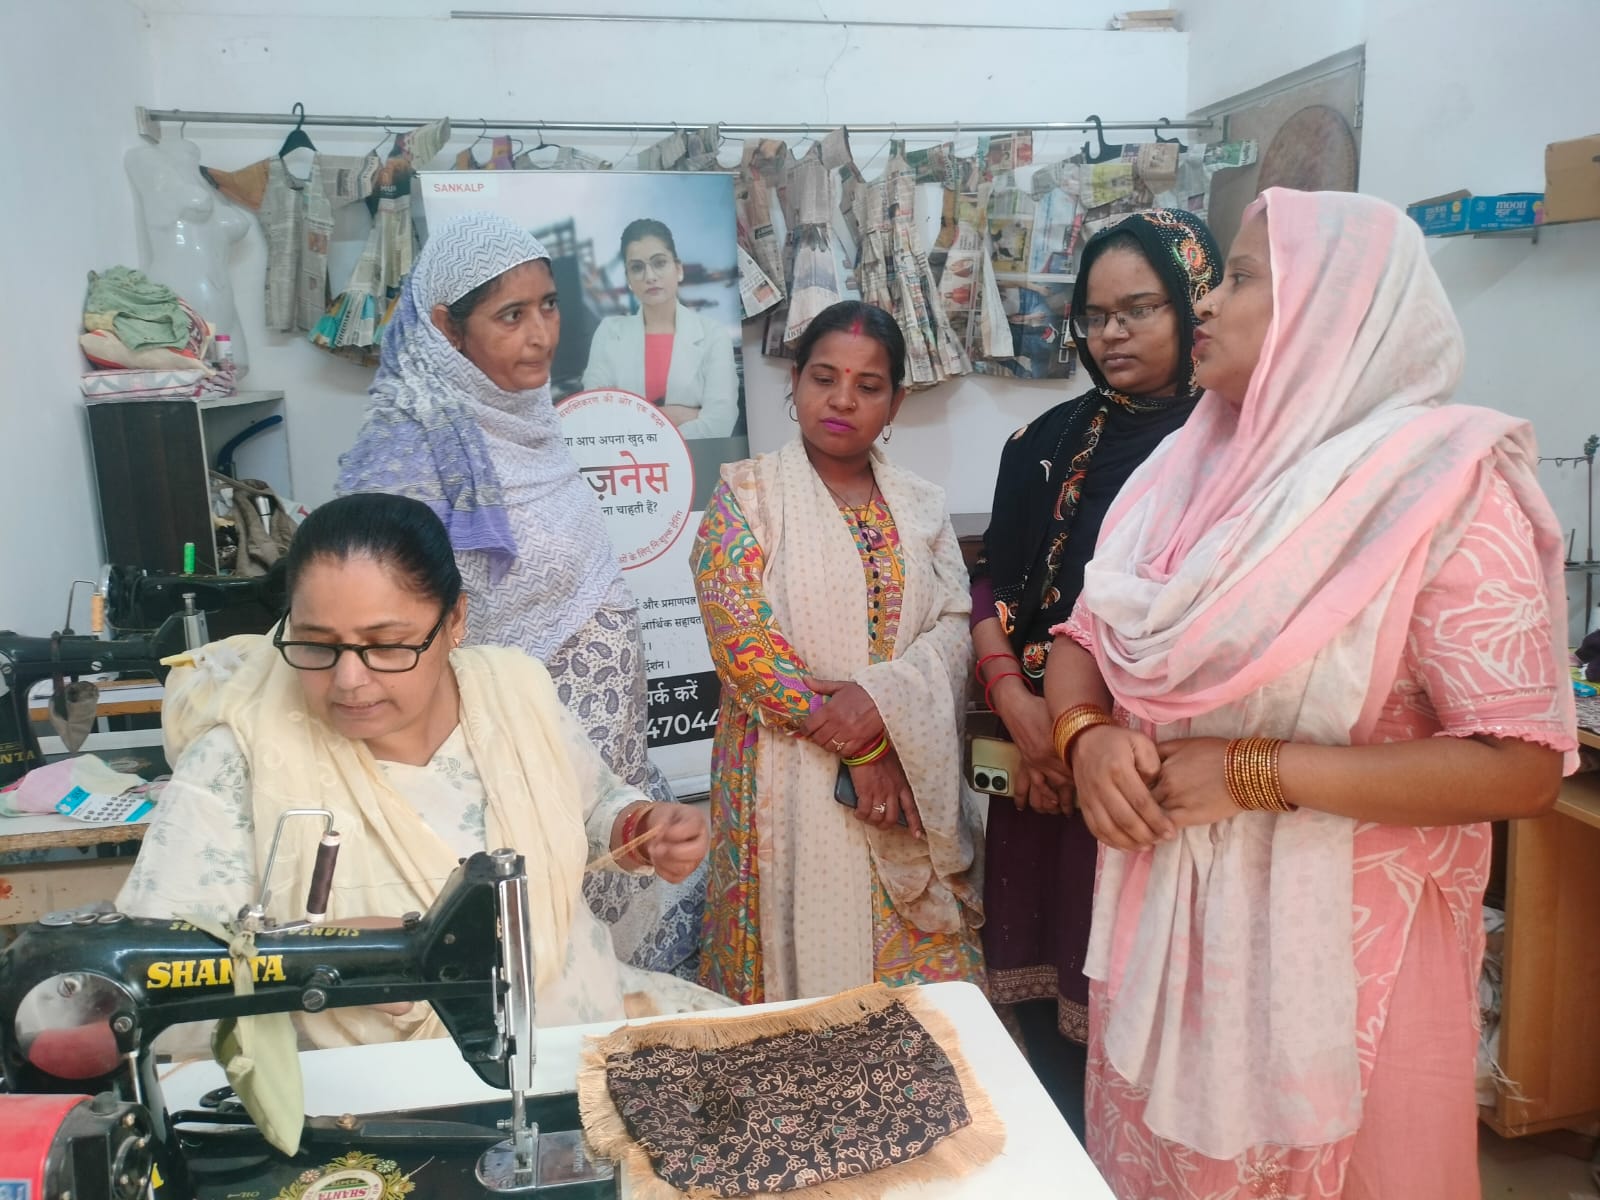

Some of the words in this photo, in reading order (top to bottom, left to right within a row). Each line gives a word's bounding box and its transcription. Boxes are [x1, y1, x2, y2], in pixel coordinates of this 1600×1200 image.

[433, 183, 485, 193] SANKALP
[576, 436, 595, 446] आप
[600, 434, 624, 445] अपना
[627, 434, 644, 447] खुद
[646, 433, 657, 442] का
[578, 450, 669, 501] ज़नेस
[616, 501, 643, 516] चाहती
[642, 597, 659, 609] और
[640, 617, 672, 630] आर्थिक
[673, 679, 699, 702] करें
[146, 954, 287, 989] SHANTA
